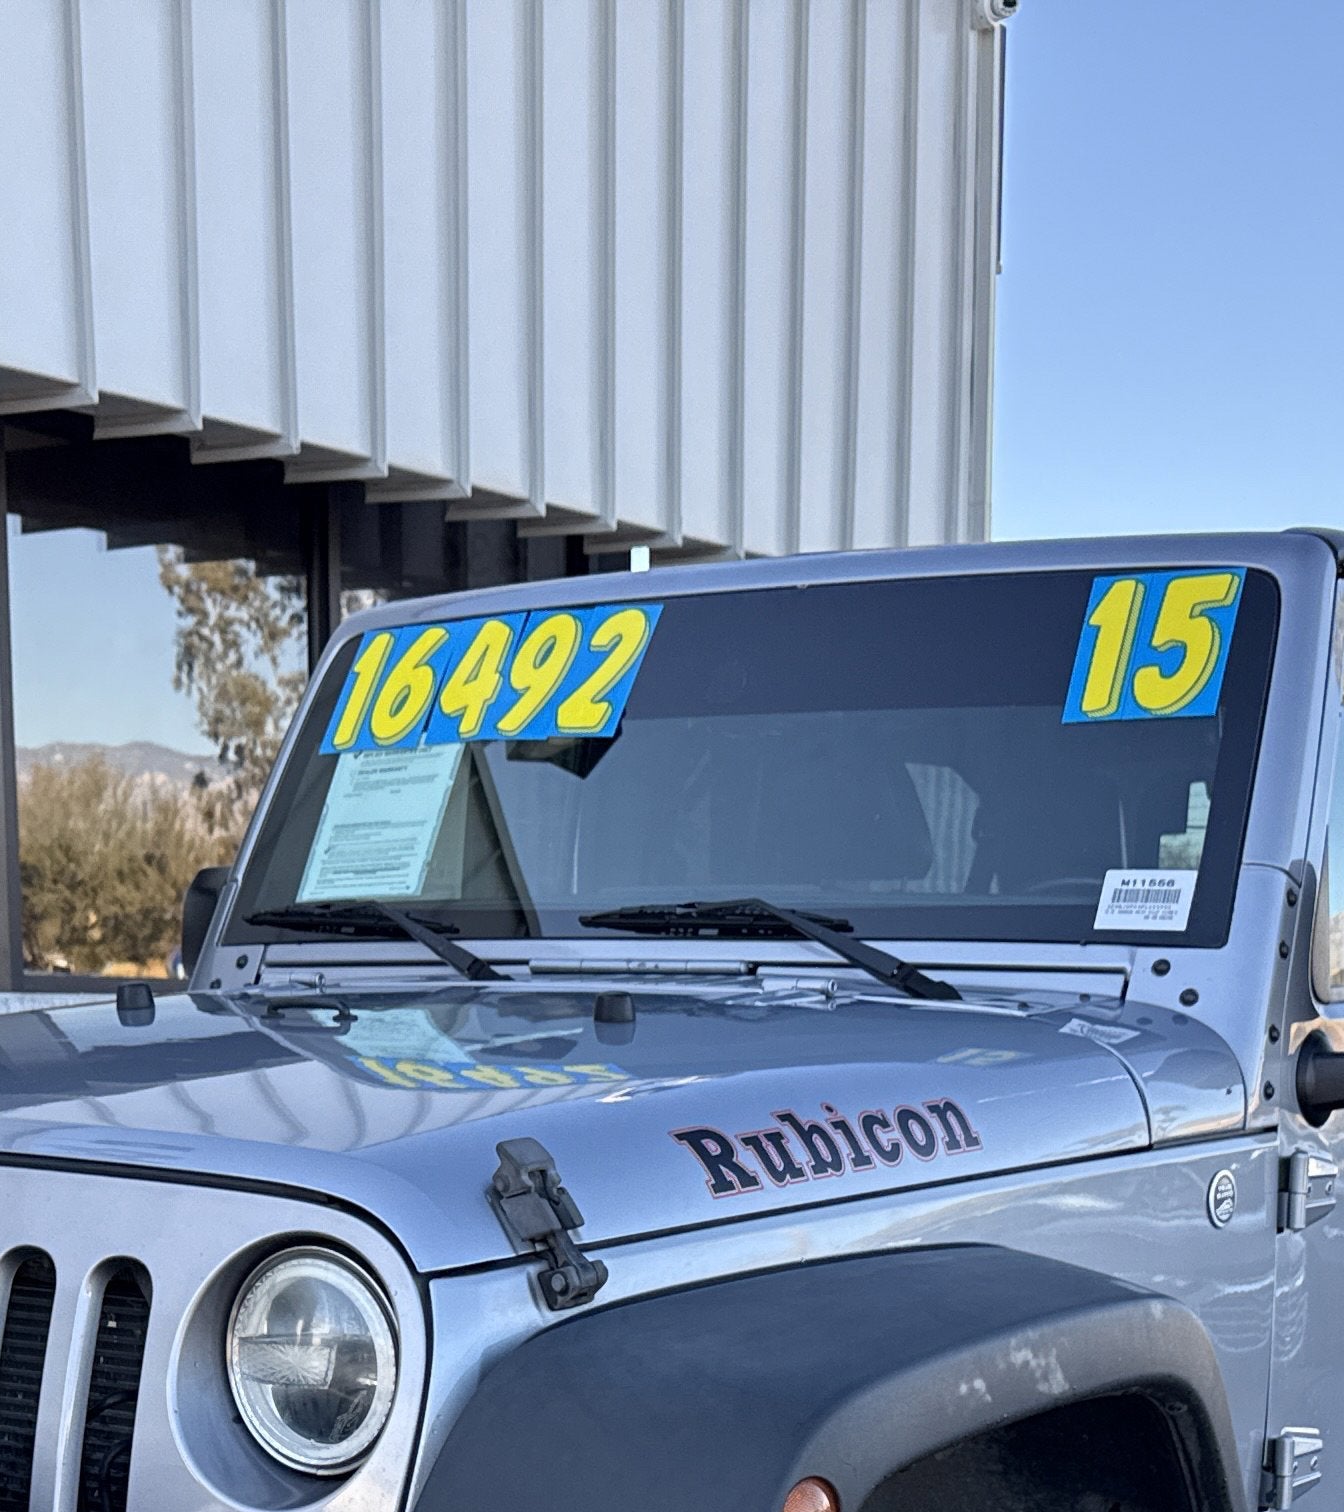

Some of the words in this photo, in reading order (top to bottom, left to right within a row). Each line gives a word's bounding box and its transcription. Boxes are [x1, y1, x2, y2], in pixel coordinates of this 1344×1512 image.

[331, 608, 650, 748] 16492
[1081, 573, 1240, 718] 15
[668, 1097, 985, 1199] Rubicon
